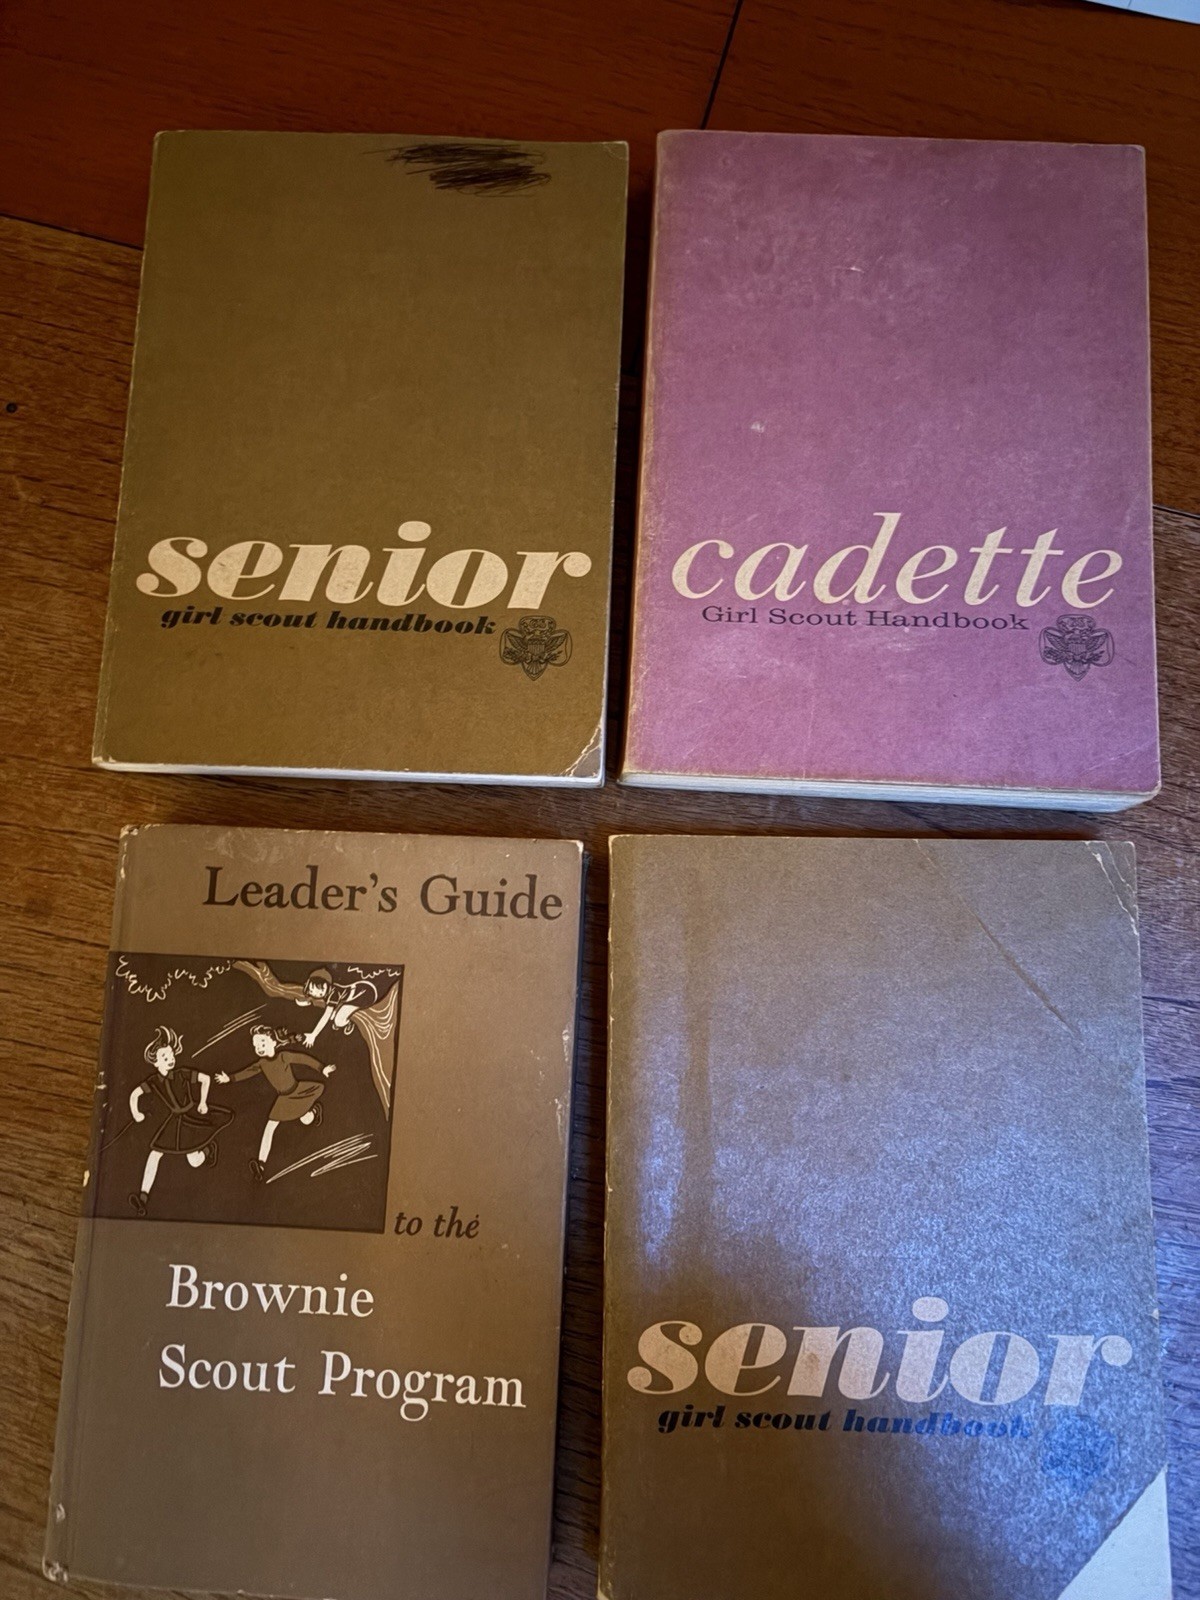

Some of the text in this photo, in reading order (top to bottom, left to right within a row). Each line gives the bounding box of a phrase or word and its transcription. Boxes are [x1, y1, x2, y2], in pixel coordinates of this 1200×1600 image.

[136, 520, 592, 610] senior
[671, 511, 1123, 609] cadette
[160, 606, 497, 635] girl scout handbook
[701, 606, 1030, 631] Girl Scout Handbook
[420, 874, 563, 921] Guide
[394, 1206, 480, 1240] to the
[165, 1264, 374, 1318] Brownie
[626, 1296, 1133, 1408] senior
[158, 1343, 527, 1422] Scout Program
[657, 1405, 1032, 1440] girl scout handbook
